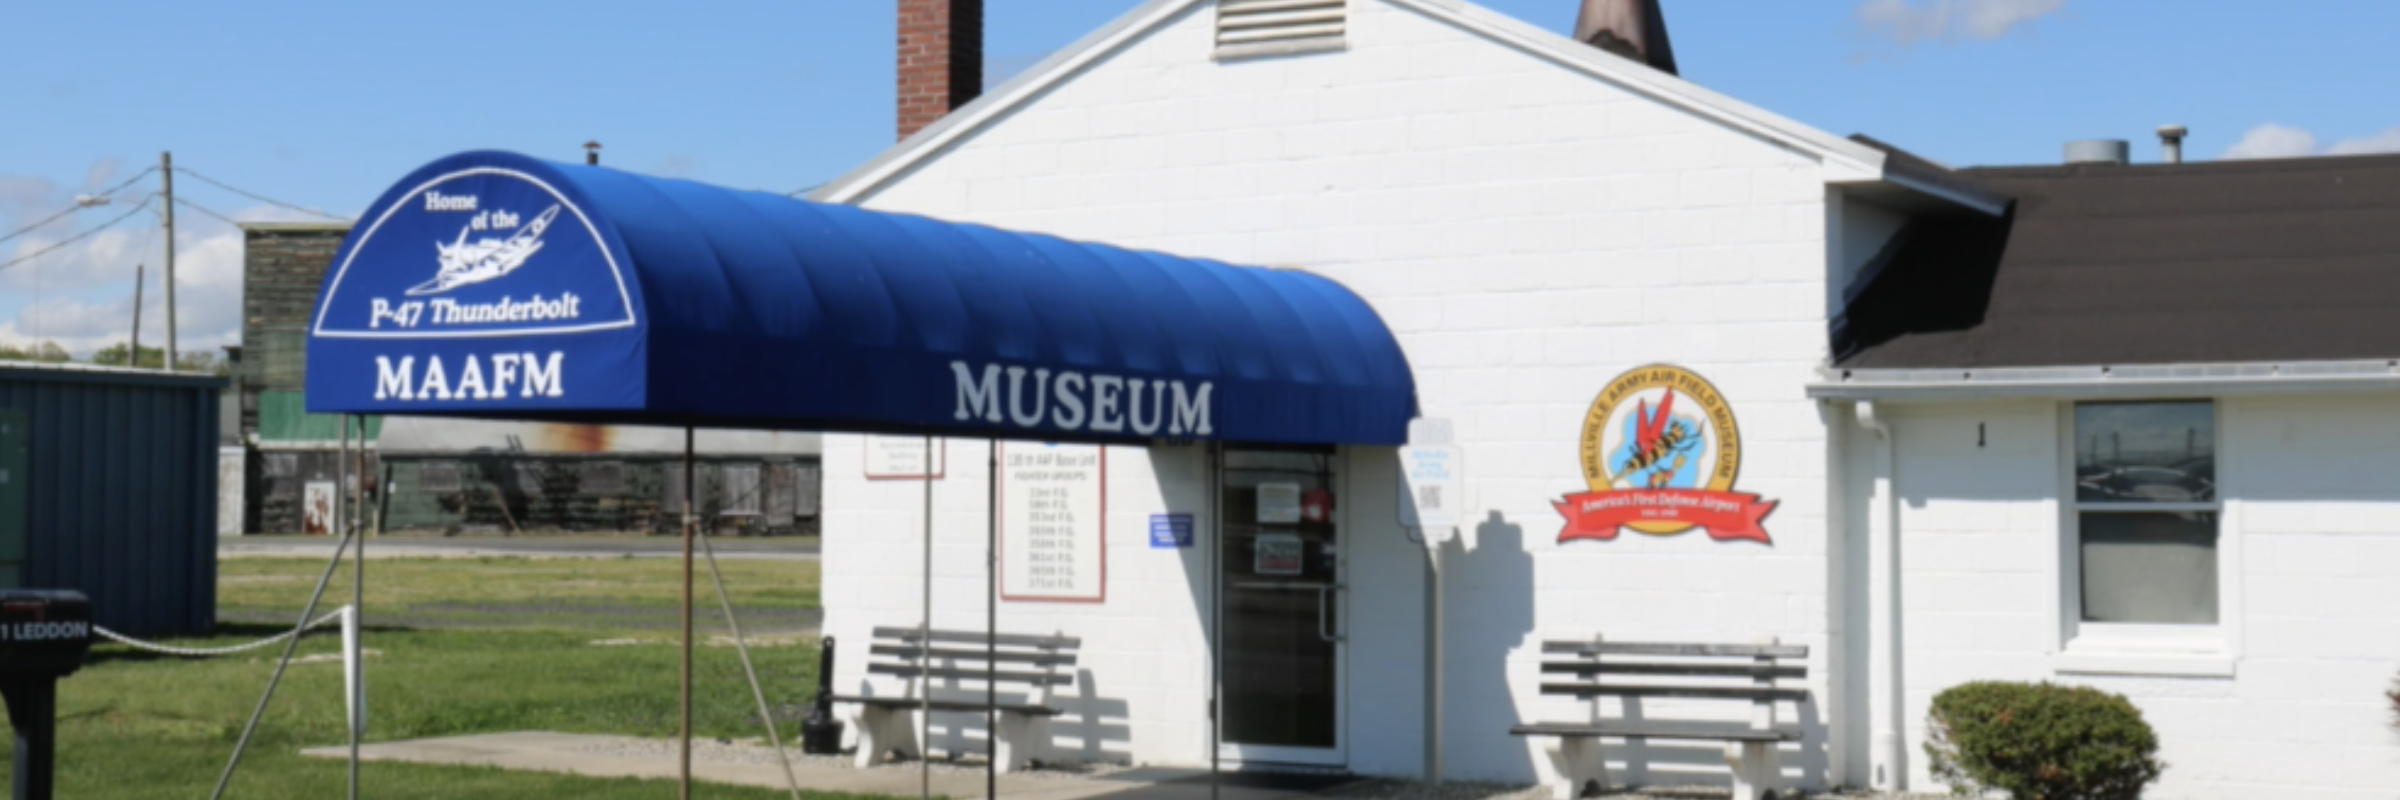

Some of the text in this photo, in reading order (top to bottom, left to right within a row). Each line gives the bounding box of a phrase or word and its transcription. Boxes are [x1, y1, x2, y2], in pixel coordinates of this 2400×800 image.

[424, 191, 478, 211] Home
[471, 210, 519, 230] of the
[369, 293, 580, 328] P-47 Thunderbolt
[374, 351, 564, 400] MAAFM
[950, 361, 1213, 435] MUSEUM
[1584, 369, 1734, 479] MILLVILLE ARMY AIR FIELD MUSEUM
[14, 621, 89, 641] LEDDON
